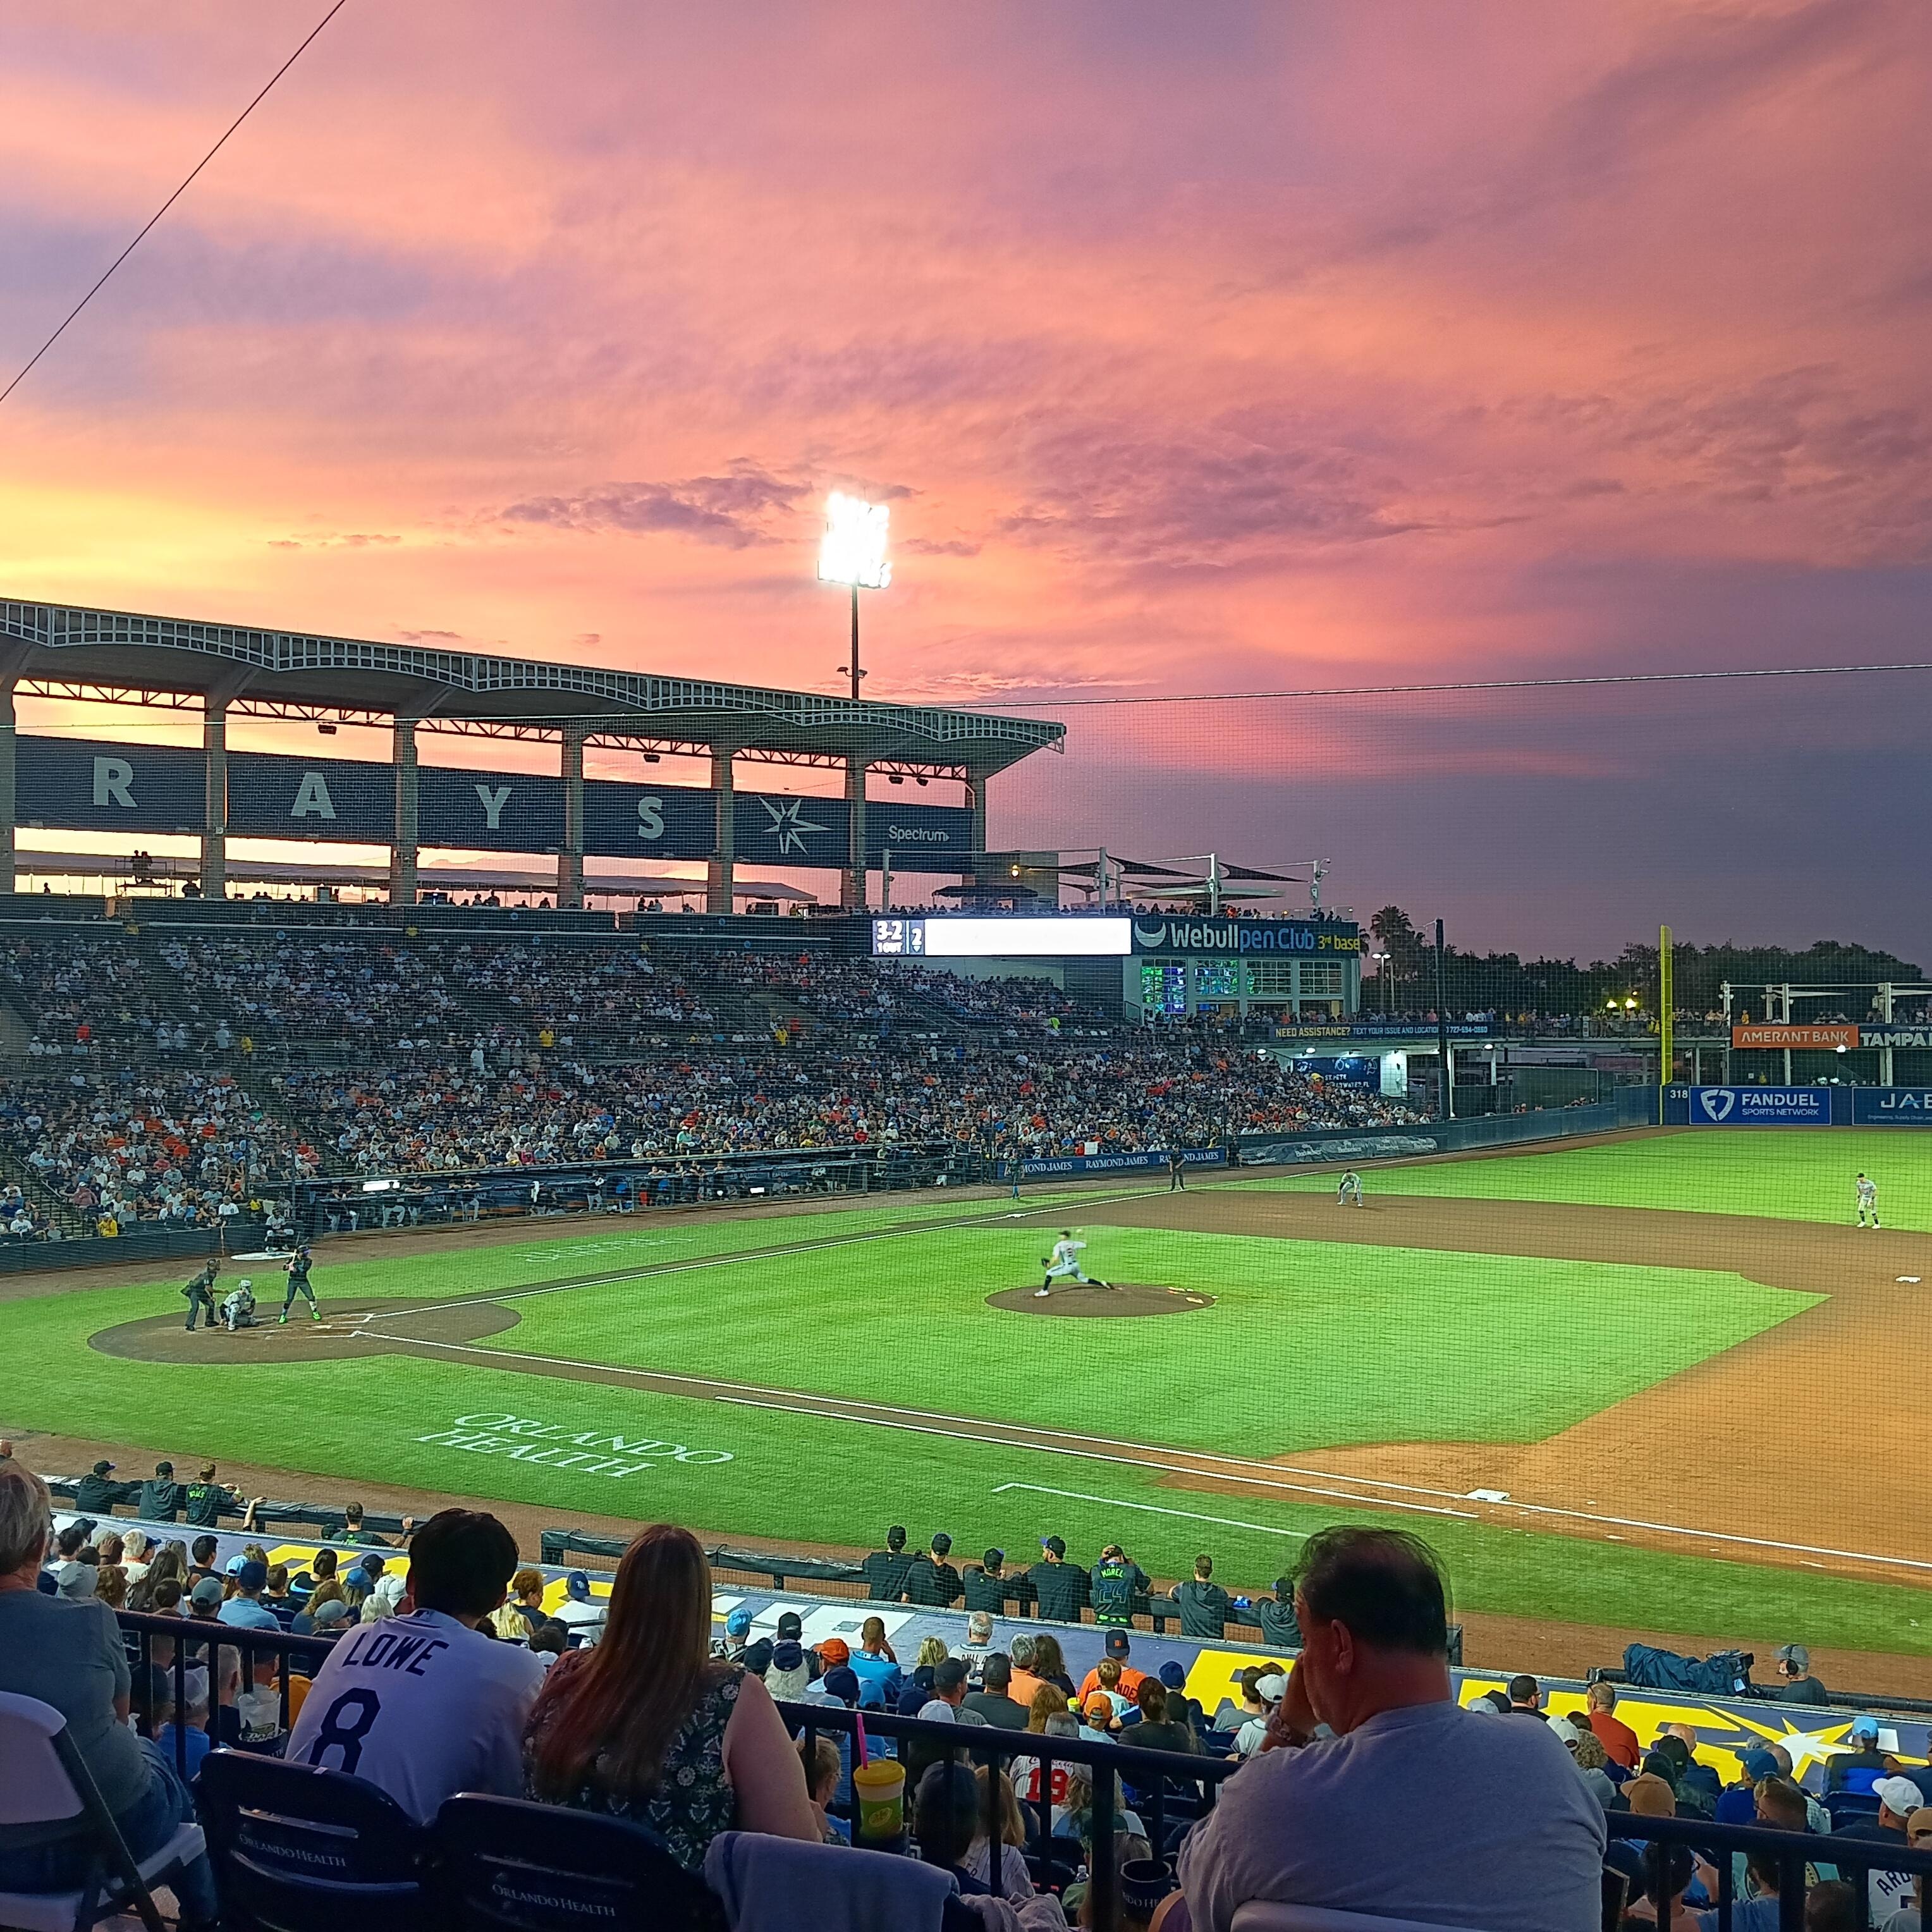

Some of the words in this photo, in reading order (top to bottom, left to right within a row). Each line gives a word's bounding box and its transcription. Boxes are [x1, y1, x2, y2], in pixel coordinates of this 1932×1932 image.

[889, 825, 948, 842] Spectrum
[912, 928, 922, 945] 2
[1278, 927, 1314, 949] Club
[1334, 936, 1359, 950] base
[1276, 1028, 1297, 1037] NEED
[1299, 1027, 1350, 1037] ASSISTANCE?
[1741, 1031, 1809, 1042] AMERANT
[1813, 1031, 1849, 1042] BANK
[1860, 1032, 1927, 1046] TAMPA
[1670, 1089, 1688, 1098] 318
[1742, 1094, 1819, 1106] FANDUEL
[1085, 1158, 1123, 1168] RAYMOND
[1124, 1156, 1148, 1165] JAMES
[1196, 1152, 1219, 1161] JAMES
[1047, 1161, 1072, 1171] JAMES
[454, 1413, 734, 1464] ORLANDO
[412, 1428, 657, 1478] HEALTH
[1101, 1568, 1123, 1578] MOREL
[1099, 1581, 1128, 1603] 24
[342, 1632, 449, 1676] LOWE
[308, 1687, 381, 1775] 8
[239, 1833, 295, 1858] ORLANDO
[297, 1849, 346, 1866] HEALTH
[492, 1884, 558, 1907] ORLANDO
[561, 1898, 616, 1916] HEALTH
